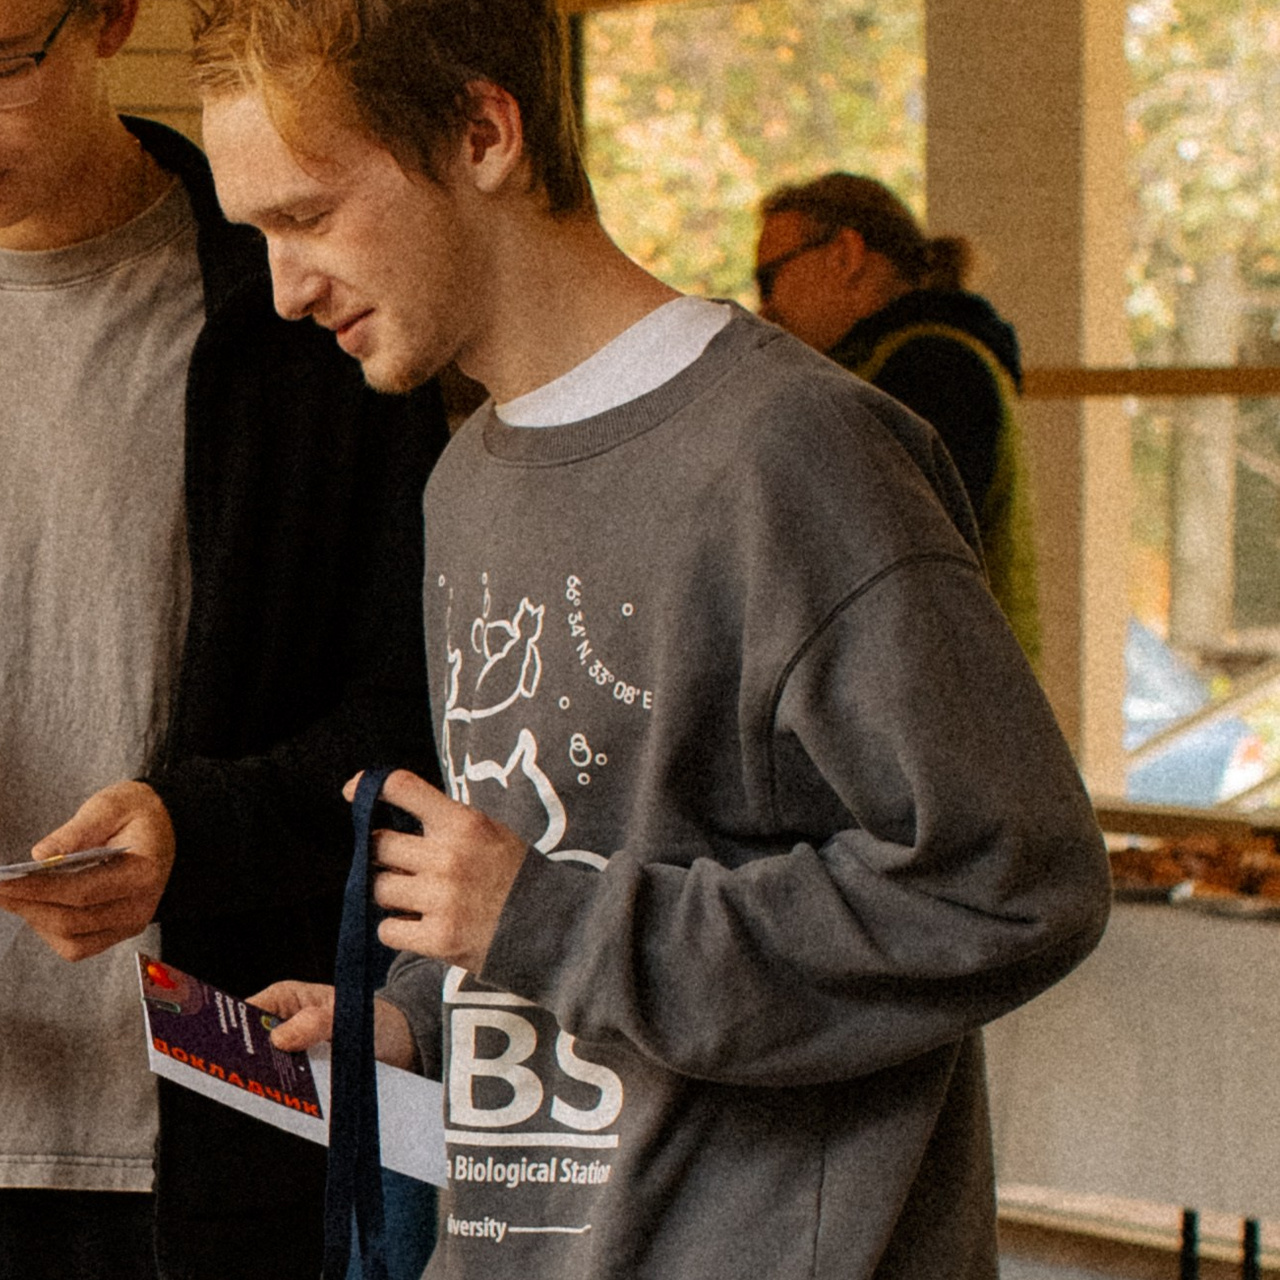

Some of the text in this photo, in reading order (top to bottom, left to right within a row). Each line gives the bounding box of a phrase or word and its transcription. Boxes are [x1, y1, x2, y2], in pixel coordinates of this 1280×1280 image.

[642, 690, 653, 710] E
[153, 1037, 320, 1117] ДОКЛАДЧИК
[454, 1154, 558, 1189] Biological
